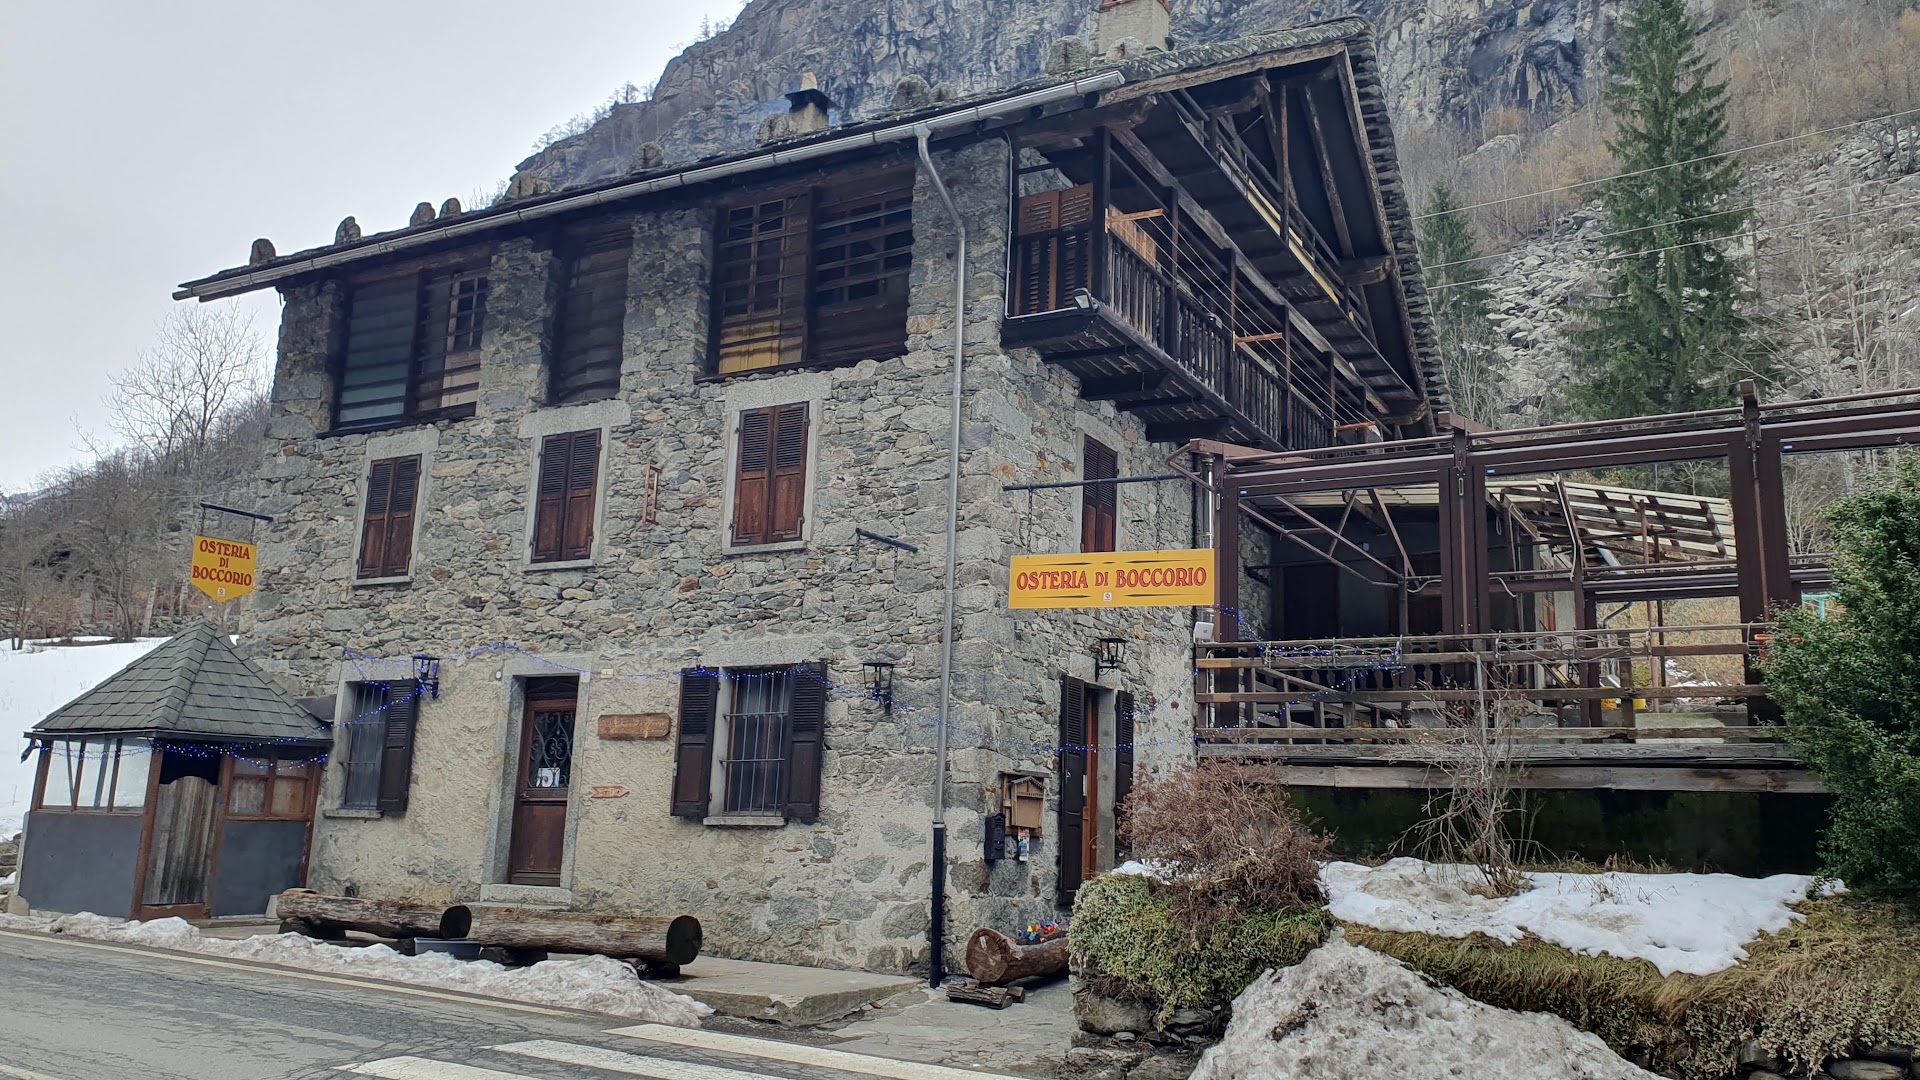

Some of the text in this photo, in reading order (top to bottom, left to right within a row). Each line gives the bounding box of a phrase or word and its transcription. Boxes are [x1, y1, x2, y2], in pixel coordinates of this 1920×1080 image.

[199, 539, 250, 559] OSTERIA
[219, 557, 229, 568] DI
[192, 565, 252, 586] BOCCORIO
[1016, 566, 1207, 590] OSTERIA DI BOCCORIO
